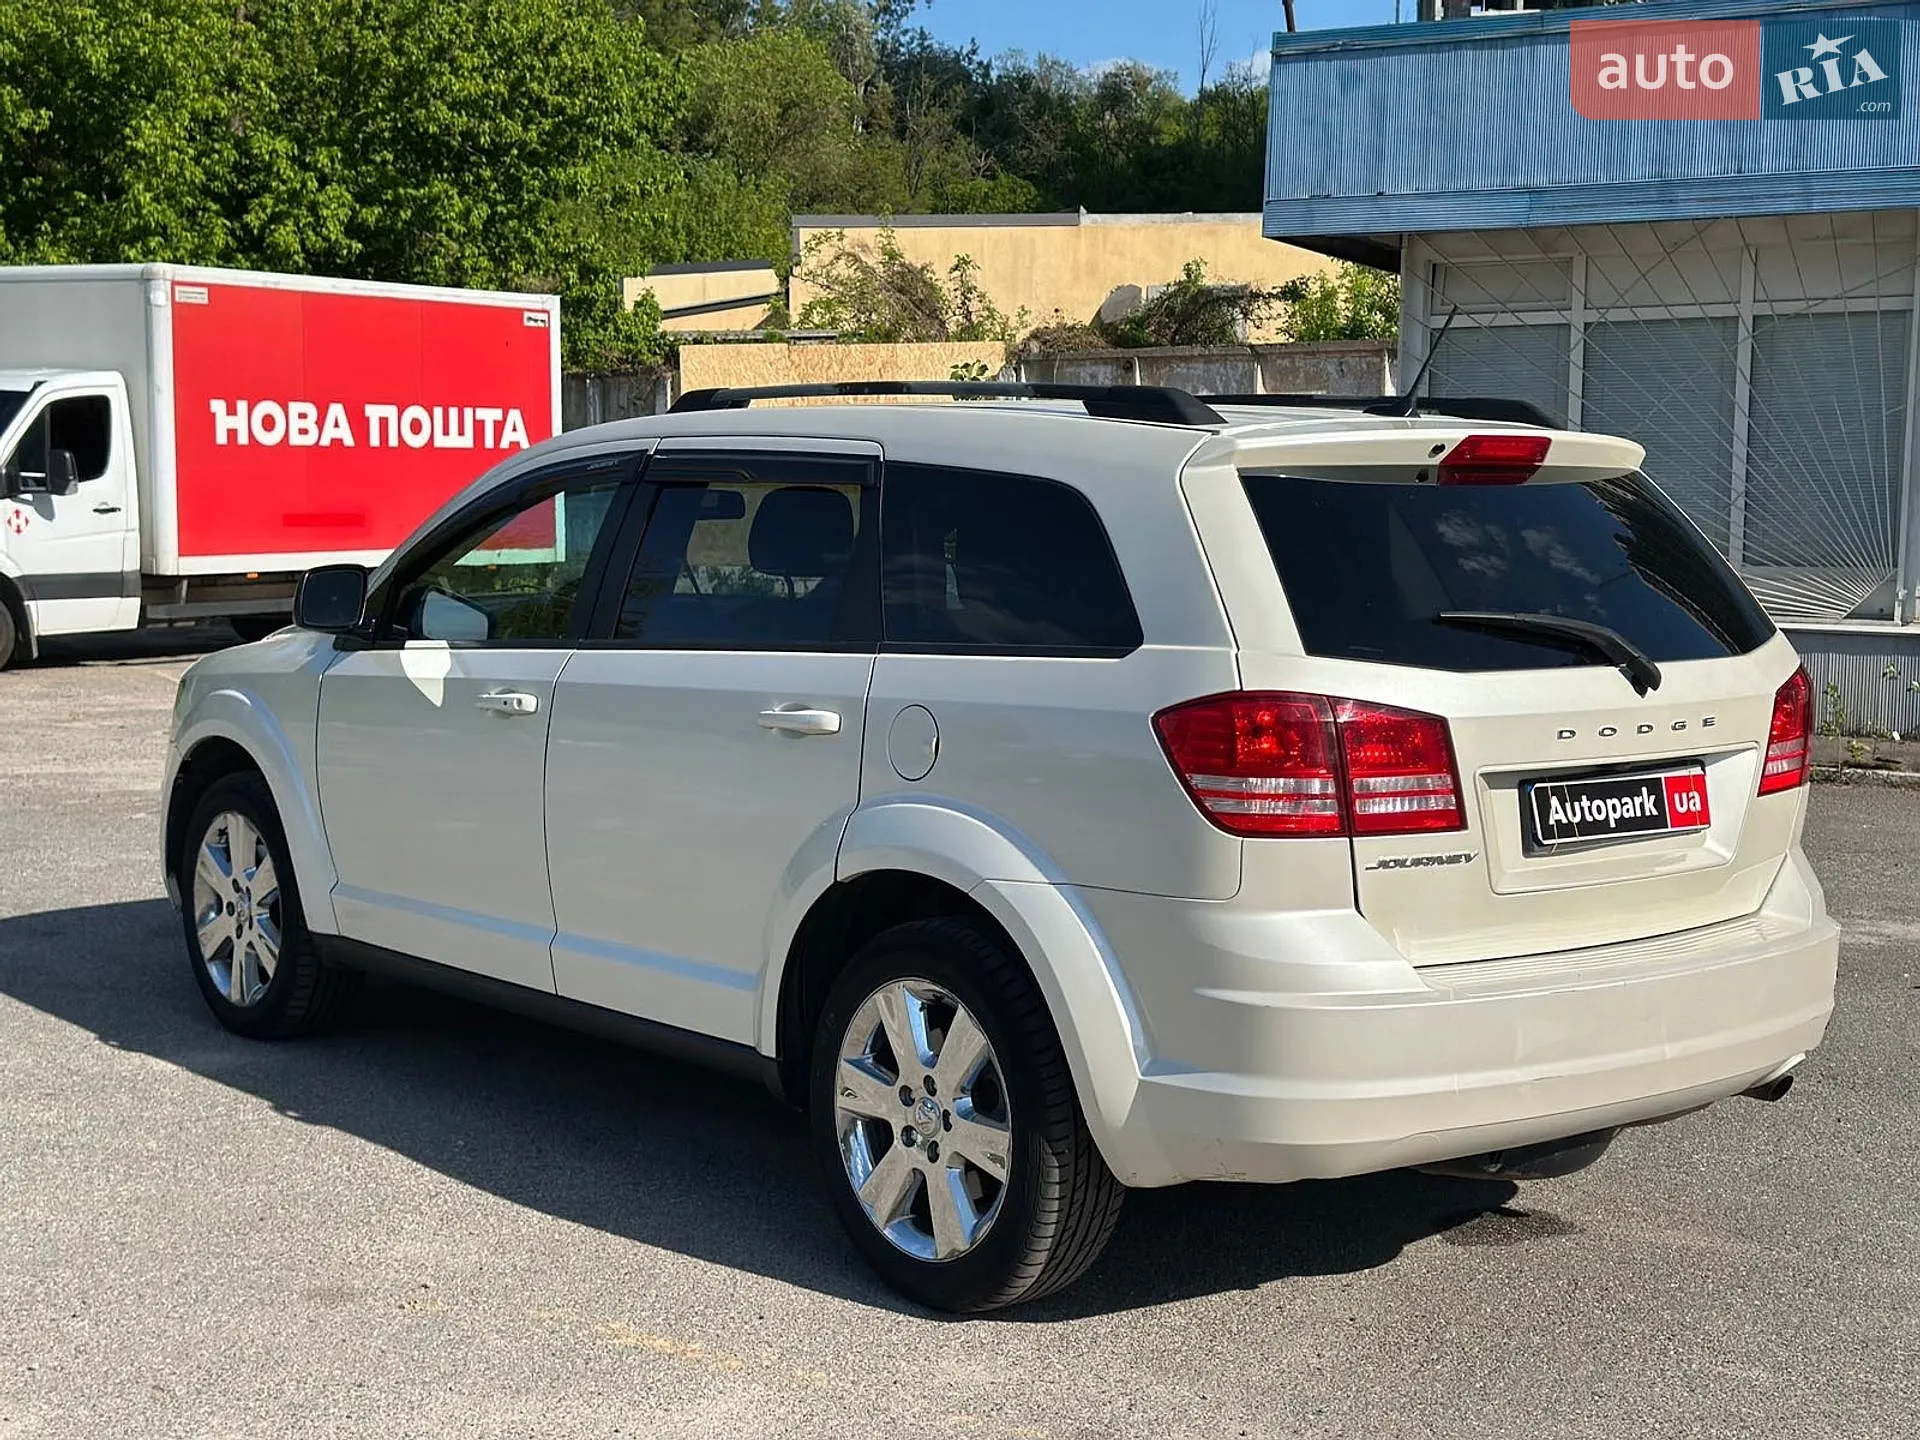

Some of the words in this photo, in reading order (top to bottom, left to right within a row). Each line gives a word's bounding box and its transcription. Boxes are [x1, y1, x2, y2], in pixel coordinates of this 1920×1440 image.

[209, 398, 355, 447] НОВА
[364, 403, 531, 449] ПОШТА
[1556, 716, 1716, 740] DODGE
[1549, 786, 1659, 829] Autopark
[1673, 790, 1702, 814] ua
[1365, 852, 1479, 871] JOURNEY
